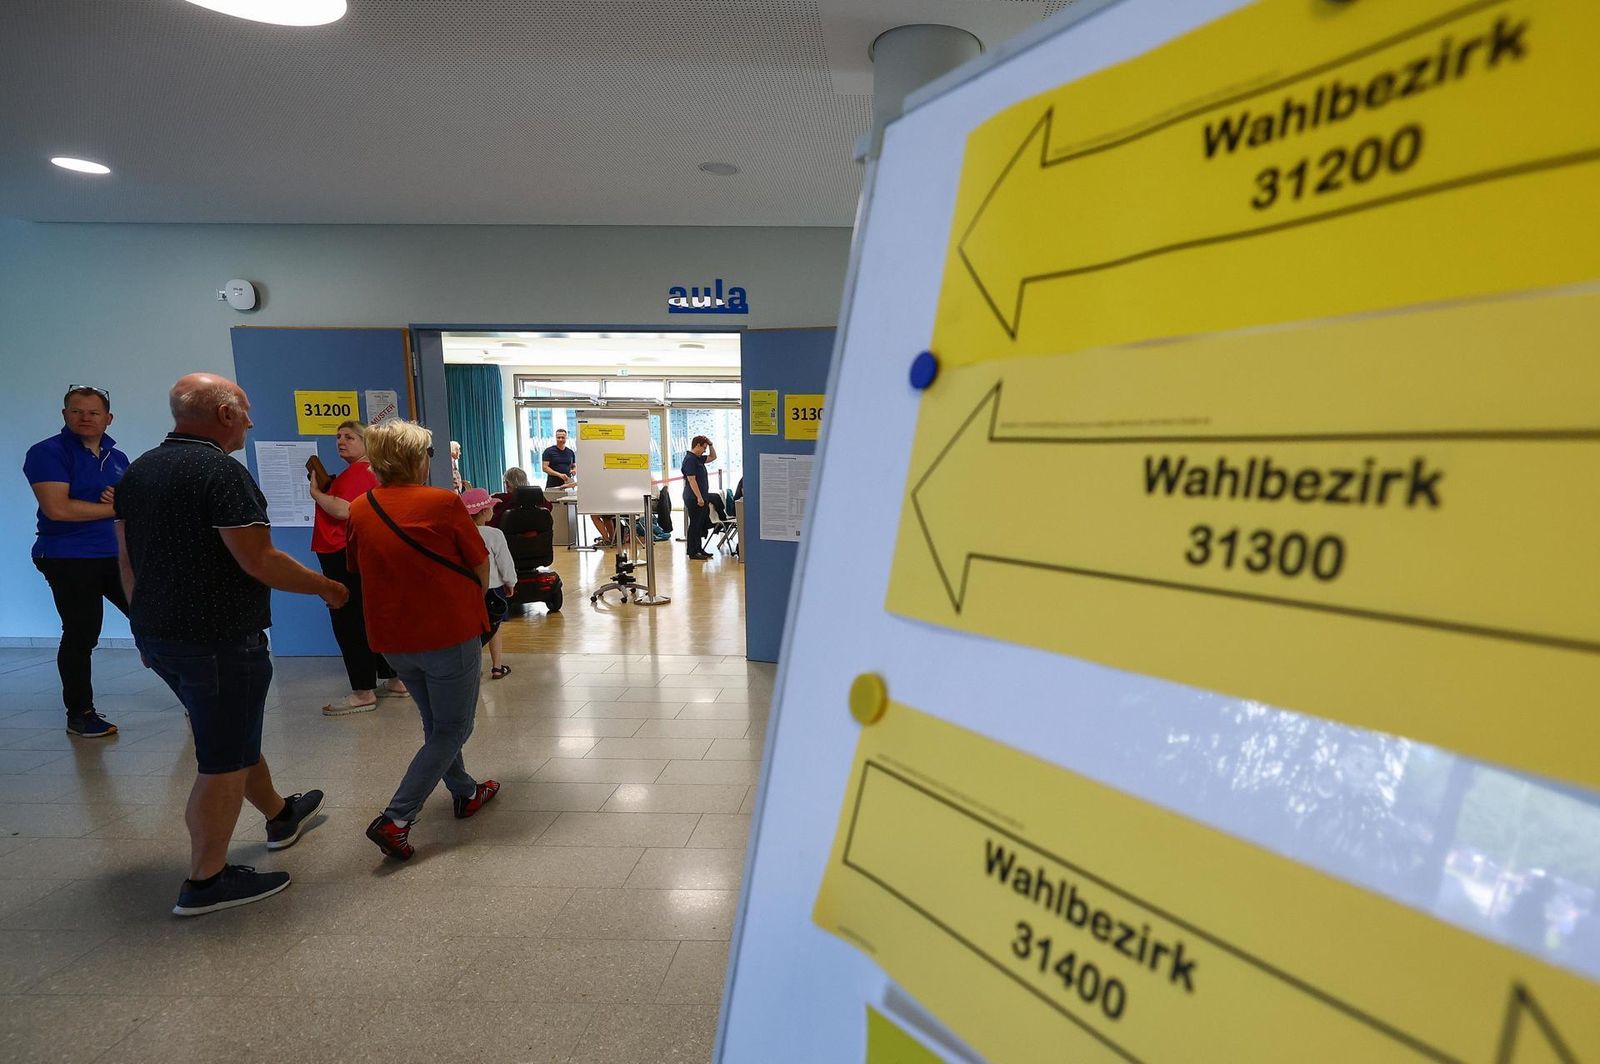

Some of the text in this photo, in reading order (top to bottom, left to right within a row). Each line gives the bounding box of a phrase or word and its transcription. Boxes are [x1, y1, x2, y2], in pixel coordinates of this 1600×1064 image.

[1203, 17, 1527, 160] Wahlbezirk
[1252, 124, 1423, 210] 31200
[668, 279, 747, 309] aula
[303, 403, 351, 417] 31200
[1144, 456, 1443, 508] Wahlbezirk
[1185, 525, 1345, 582] 31300
[985, 839, 1196, 993] Wahlbezirk
[1011, 920, 1127, 1021] 31400
